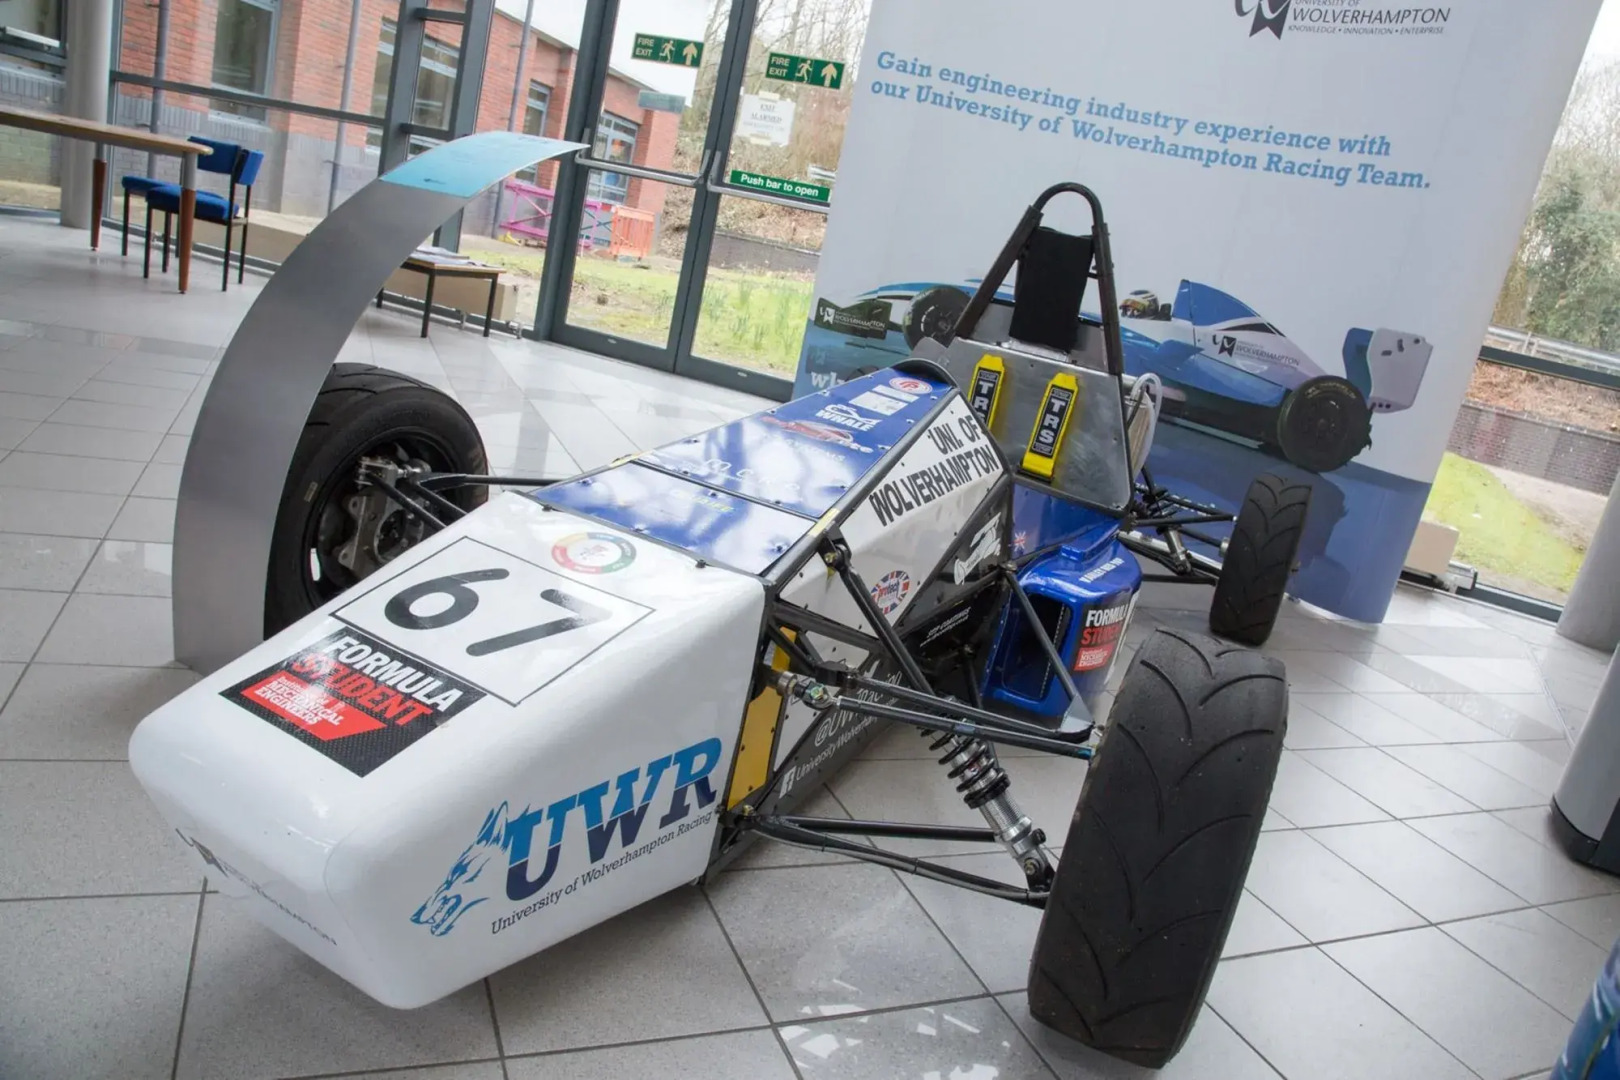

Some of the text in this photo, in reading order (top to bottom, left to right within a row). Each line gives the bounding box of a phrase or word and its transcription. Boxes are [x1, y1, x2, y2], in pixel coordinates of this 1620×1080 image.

[1288, 25, 1444, 35] KNOWLEDGE INNOVATION ENTERPRISE
[1292, 7, 1451, 25] WOLVERHAMPTON
[635, 46, 652, 57] EXIT
[637, 37, 654, 47] FIRE
[771, 56, 790, 67] FIRE
[769, 66, 787, 77] EXIT
[877, 50, 1391, 156] Gain engineering industry experience with
[871, 80, 1431, 189] our University of Wolverhampton Racing Team.
[740, 173, 819, 198] Push bar to open
[815, 409, 874, 432] WHALE
[957, 414, 981, 443] OF
[1038, 398, 1065, 444] TRS
[868, 444, 999, 527] WOLVERHAMPTON
[384, 568, 612, 657] 67
[292, 652, 434, 727] STUDENT
[324, 635, 464, 713] FORMULA
[254, 687, 323, 726] ENGINEERS
[266, 680, 345, 726] MECHANICAL
[505, 736, 723, 902] UWR
[491, 810, 713, 936] University of Wolverhampton Racing
